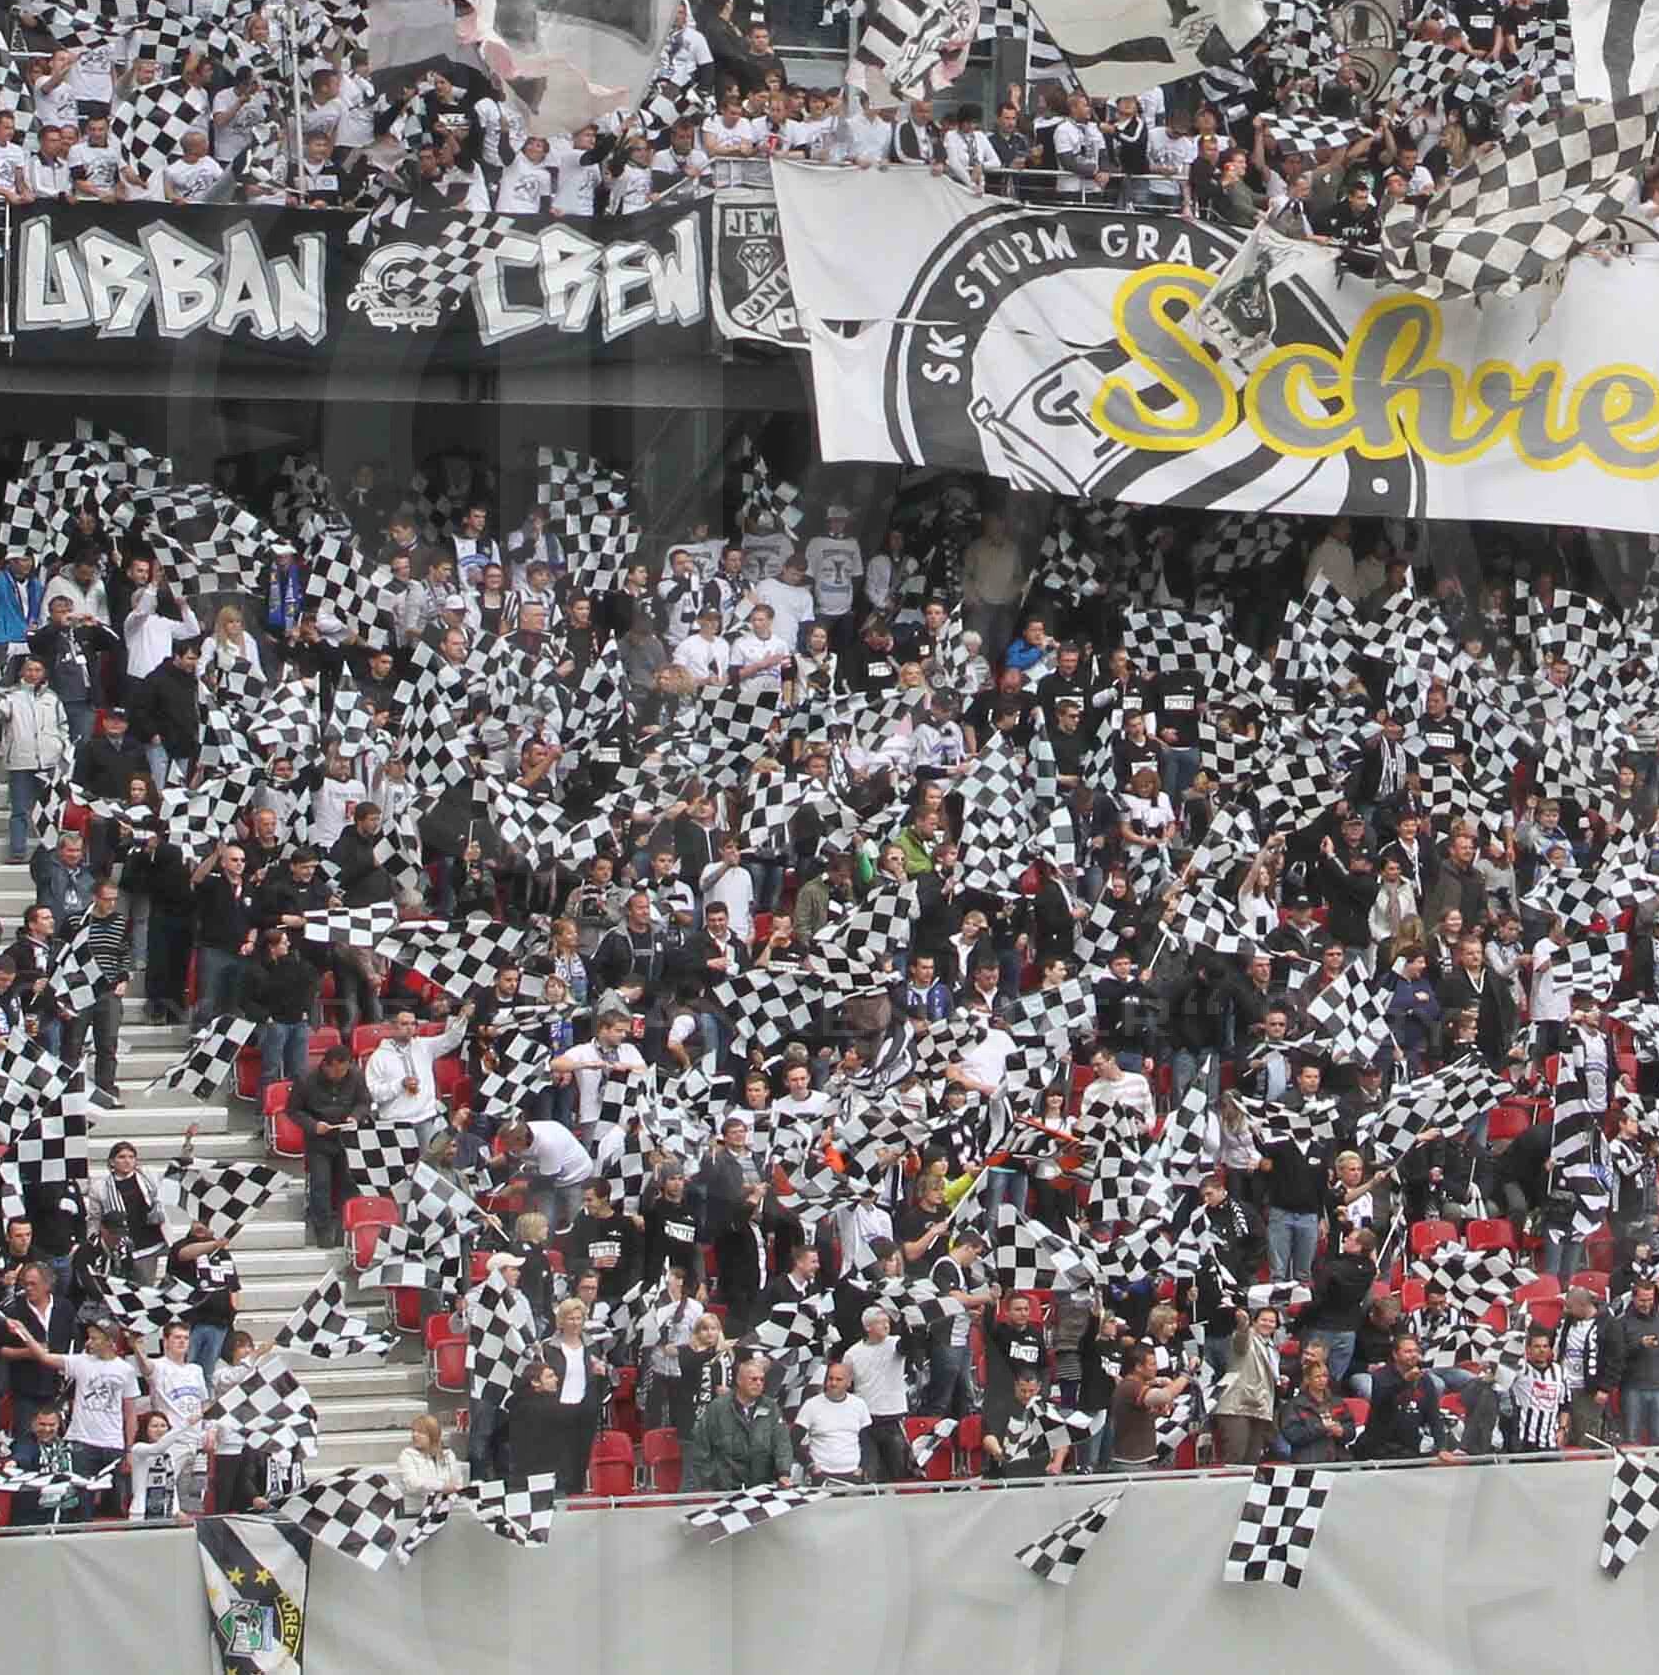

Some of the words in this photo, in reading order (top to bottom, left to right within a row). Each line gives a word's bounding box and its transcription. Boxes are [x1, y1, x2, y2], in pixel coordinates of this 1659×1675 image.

[14, 214, 329, 345] URBAN
[471, 210, 707, 347] CREW
[727, 219, 781, 237] JEW
[921, 325, 968, 385] SK
[953, 223, 1079, 311] STURM
[1099, 223, 1230, 274] GRAZ
